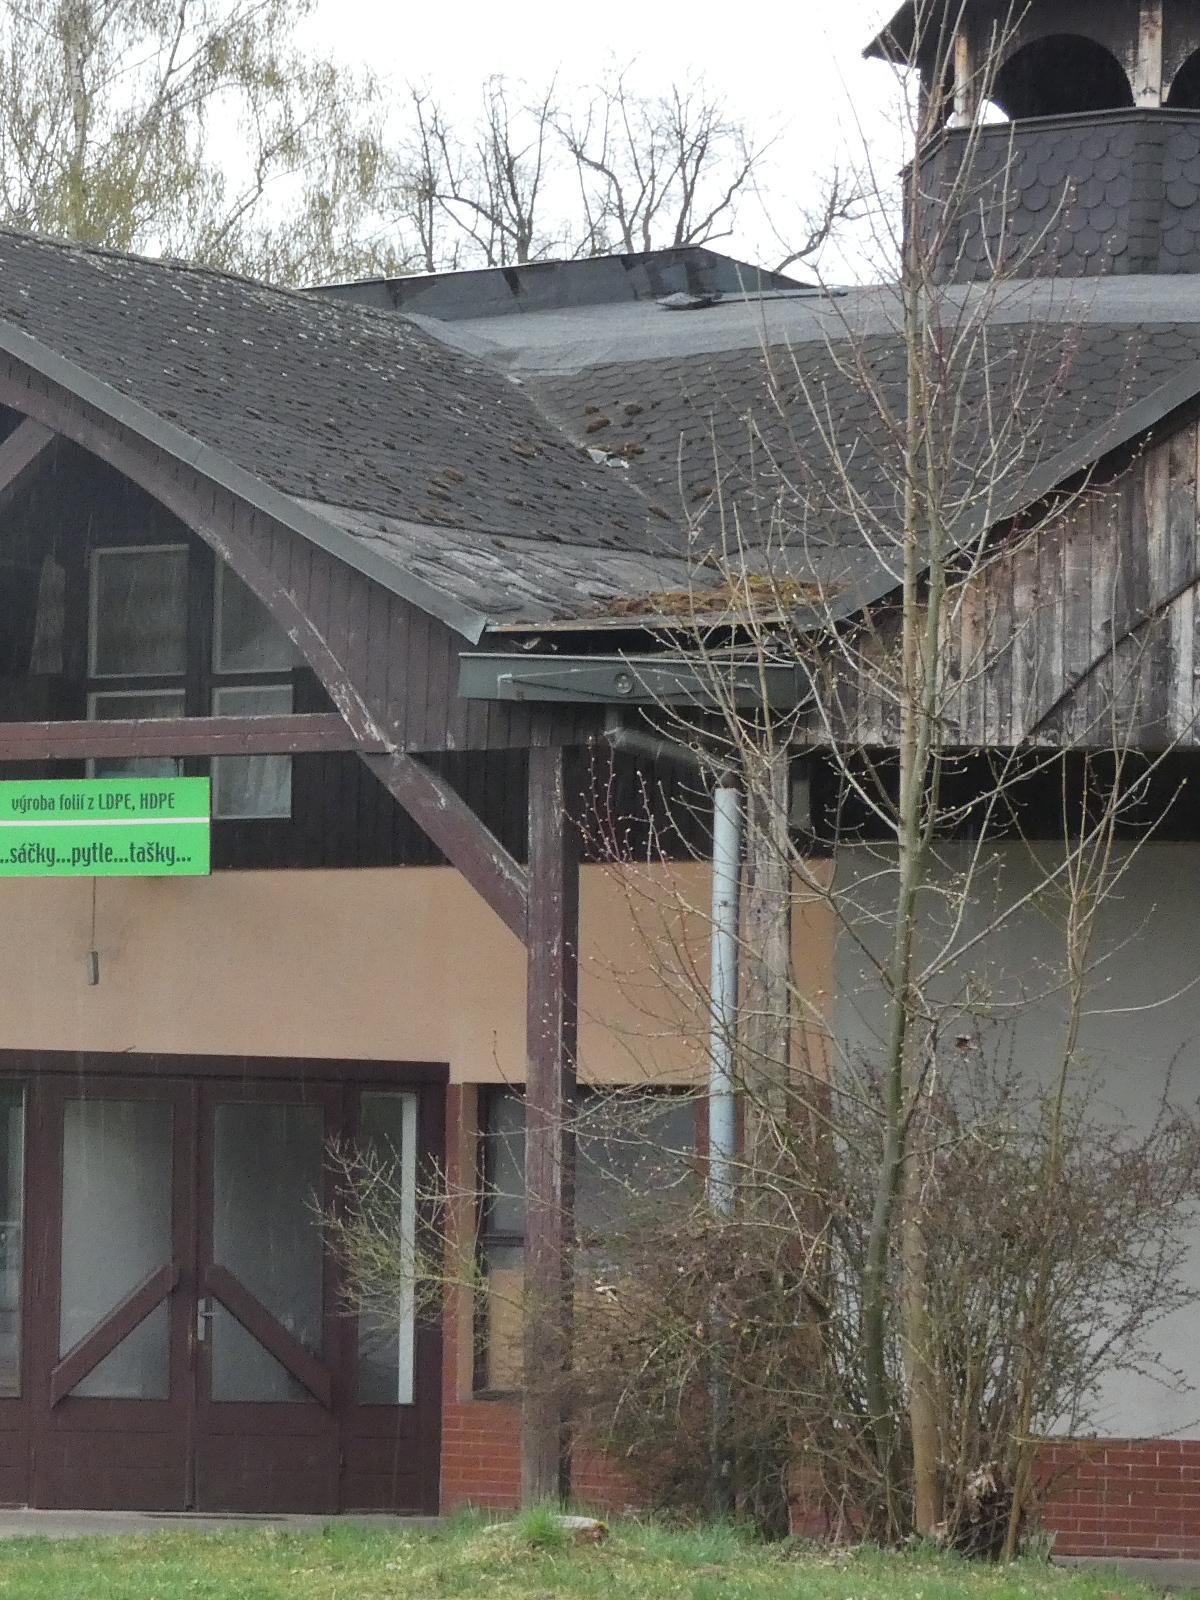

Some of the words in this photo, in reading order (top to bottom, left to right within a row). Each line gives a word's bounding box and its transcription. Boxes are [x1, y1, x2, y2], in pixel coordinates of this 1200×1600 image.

[11, 794, 55, 814] výroba
[87, 797, 95, 811] z
[98, 793, 135, 811] LDPE,
[139, 792, 175, 810] HDPE
